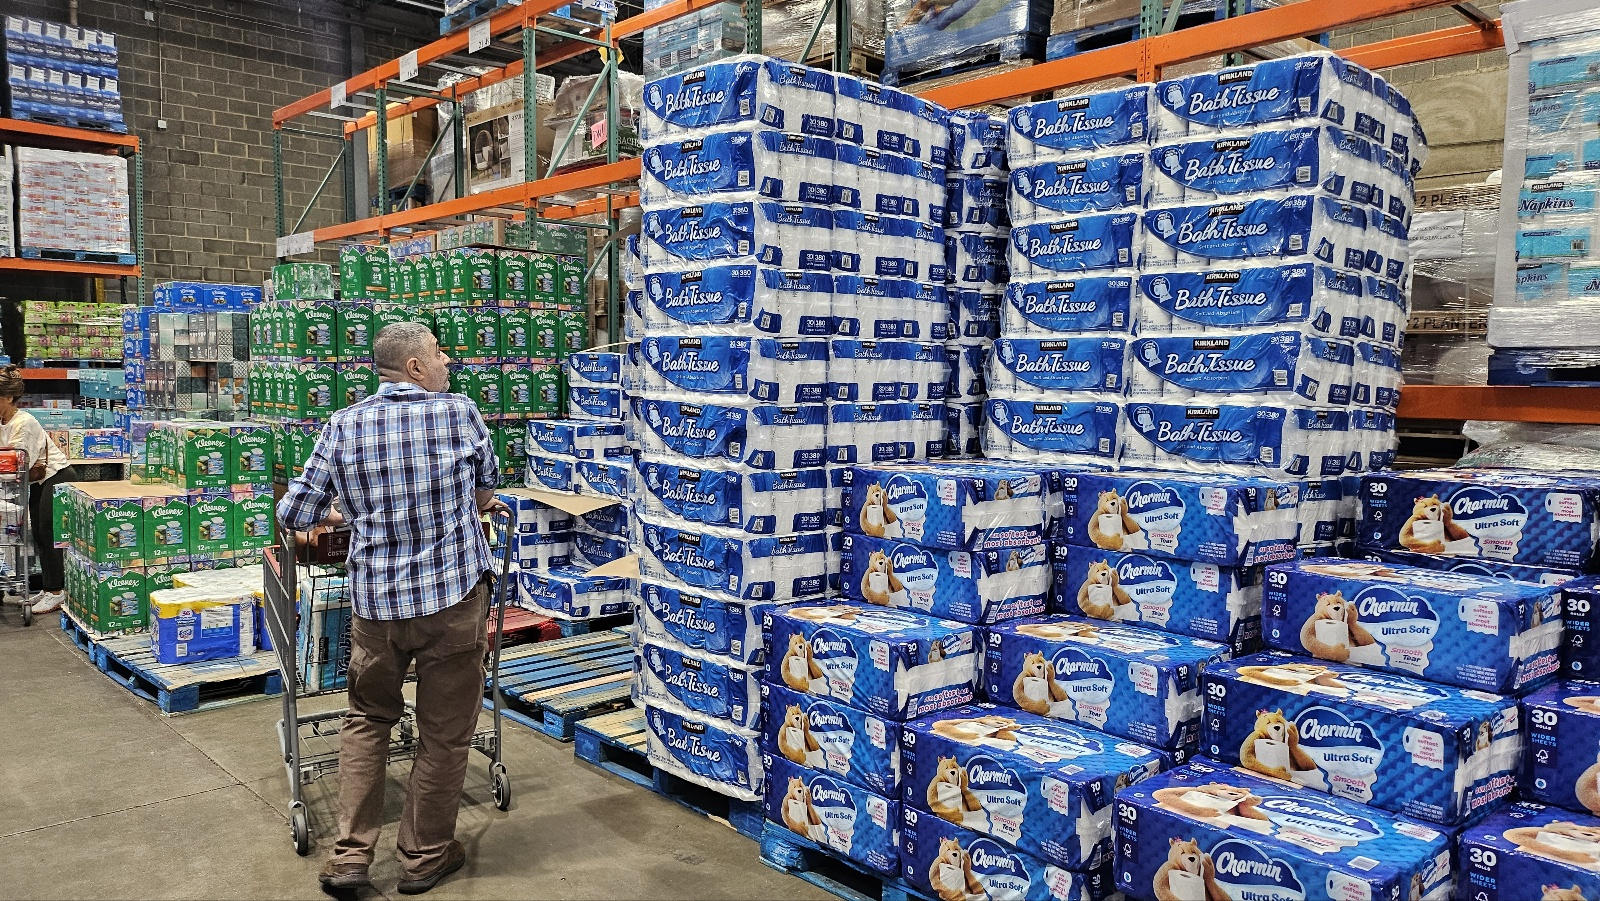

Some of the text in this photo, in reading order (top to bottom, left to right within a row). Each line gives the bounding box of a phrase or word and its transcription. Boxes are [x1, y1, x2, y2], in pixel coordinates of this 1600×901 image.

[1220, 71, 1254, 82] KIRKLAND
[665, 92, 693, 114] Bath
[692, 85, 725, 109] Tissue
[1059, 99, 1089, 110] KIRKLAND
[1189, 85, 1280, 114] Bath Tissue
[1034, 112, 1114, 138] Bath Tissue
[664, 154, 721, 180] Bath Tissue
[1185, 150, 1276, 180] Bath Tissue
[1034, 176, 1110, 198] Bath Tissue
[1532, 182, 1563, 190] KIRKLAND
[1420, 196, 1426, 206] 2
[1518, 197, 1574, 214] Napkins
[665, 220, 722, 244] Bath Tissue
[1178, 217, 1268, 244] Bath Tissue
[1030, 234, 1102, 258] Bath Tissue
[1206, 272, 1240, 280] KIRKLAND
[666, 285, 722, 308] Bath Tissue
[1174, 286, 1266, 310] Bath Tissue
[1026, 295, 1096, 314] Bath Tissue
[1414, 317, 1420, 329] 2
[1042, 340, 1067, 348] KIRKLAND
[1194, 340, 1230, 348] KIRKLAND
[1280, 335, 1294, 344] 380
[662, 351, 720, 372] Bath Tissue
[1016, 354, 1091, 373] Bath Tissue
[1164, 355, 1208, 374] Bath
[344, 373, 369, 381] Kleenex
[1035, 404, 1062, 412] KIRKLAND
[1187, 408, 1218, 416] KIRKLAND
[1257, 410, 1266, 418] 30
[685, 420, 717, 440] Tissue
[1011, 416, 1084, 434] Bath Tissue
[1157, 422, 1242, 443] Bath Tissue
[195, 438, 226, 449] Kleenex
[238, 435, 267, 445] Kleenex
[1065, 478, 1078, 487] 30
[1370, 482, 1387, 492] 30
[684, 483, 716, 505] Tissue
[888, 483, 918, 500] Charmin
[1129, 489, 1171, 508] Charmin
[152, 508, 184, 518] Kleenex
[198, 504, 228, 514] Kleenex
[242, 501, 270, 511] Kleenex
[900, 505, 912, 513] Ultra
[1454, 497, 1509, 515] Charmin
[105, 510, 138, 520] Kleenex
[1144, 512, 1180, 523] Ultra Soft
[1474, 519, 1519, 530] Ultra Soft
[1055, 546, 1067, 556] 30
[684, 549, 715, 570] Tissue
[894, 553, 927, 567] Charmin
[907, 574, 921, 582] Ultra
[1120, 563, 1163, 580] Charmin
[1269, 572, 1287, 584] 30
[107, 578, 140, 590] Kleenex
[154, 576, 173, 586] Klee
[1136, 587, 1153, 595] Ultra
[1359, 597, 1419, 616] Charmin
[1567, 599, 1590, 612] 30
[684, 608, 716, 633] Tissue
[1382, 625, 1430, 635] Ultra Soft
[813, 638, 847, 653] Charmin
[990, 633, 1001, 644] 30
[1056, 658, 1100, 675] Charmin
[686, 672, 718, 697] Tissue
[1072, 684, 1108, 693] Ultra Soft
[1207, 683, 1226, 697] 30
[918, 702, 937, 714] most
[810, 711, 844, 727] Charmin
[1531, 710, 1557, 726] 30
[1300, 718, 1364, 742] Charmin
[1531, 733, 1556, 741] WIDER
[903, 731, 916, 745] 30
[688, 735, 720, 762] Tissue
[1323, 753, 1374, 764] Ultra Soft
[970, 765, 1013, 787] Charmin
[1333, 776, 1367, 788] Smooth
[812, 785, 846, 804] Charmin
[1345, 784, 1364, 794] Tear
[986, 795, 1022, 806] Ultra Soft
[824, 811, 852, 821] Ultra Soft
[904, 809, 917, 823] 30
[1119, 804, 1137, 821] 30
[1264, 800, 1359, 826] Charmin
[1002, 824, 1016, 832] Tear
[973, 848, 1016, 869] Charmin
[1470, 849, 1496, 866] 30
[1216, 851, 1282, 881] Charmin
[1470, 872, 1496, 884] WIDER
[1470, 878, 1496, 890] SHEETS
[989, 879, 1024, 893] Ultra Soft
[1241, 890, 1269, 901] Ultra
